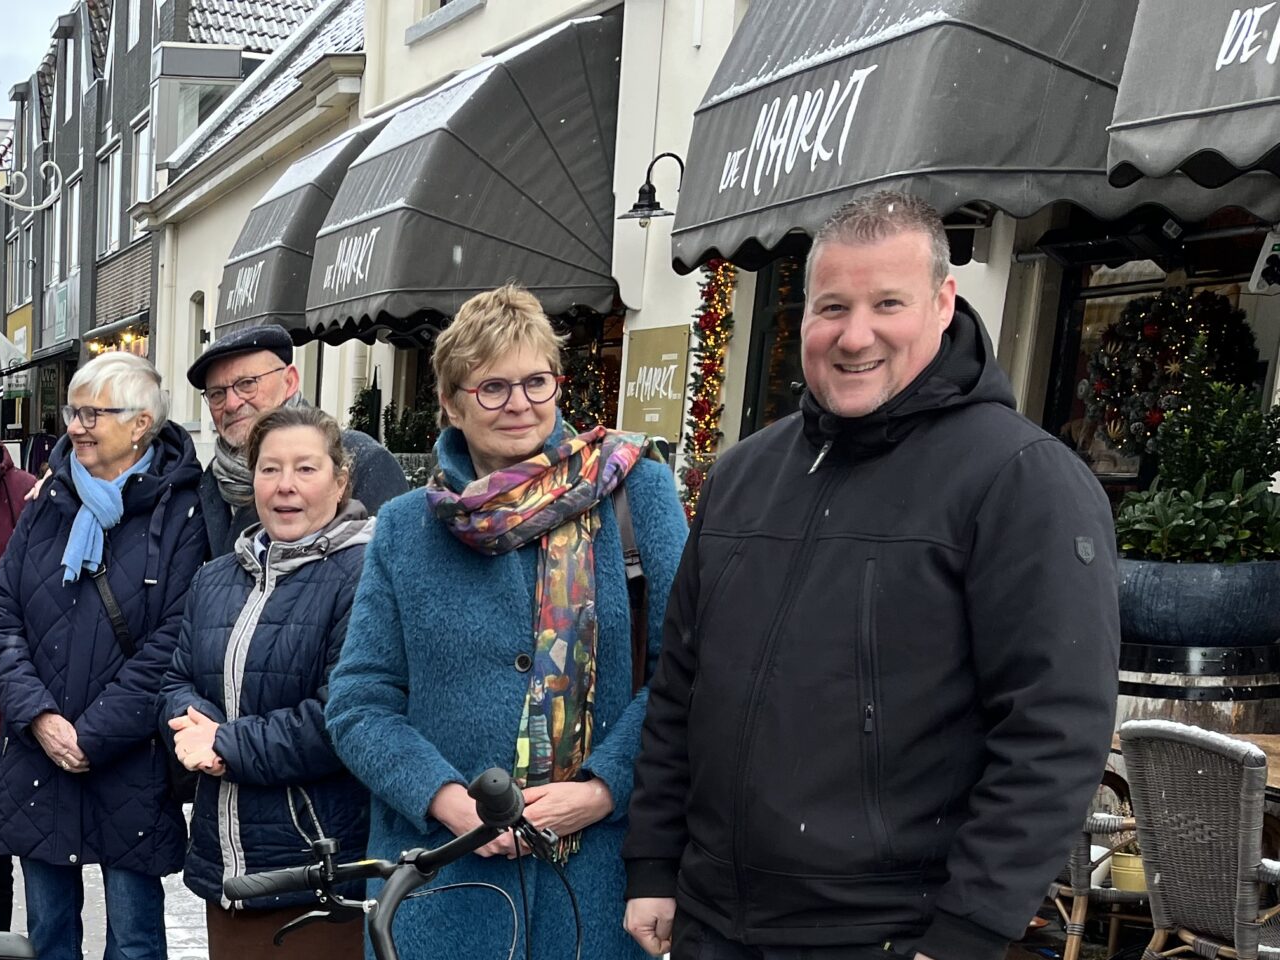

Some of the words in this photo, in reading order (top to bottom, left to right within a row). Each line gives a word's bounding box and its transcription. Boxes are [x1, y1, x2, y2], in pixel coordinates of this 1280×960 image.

[1215, 1, 1278, 71] DE
[718, 147, 748, 194] DE
[740, 64, 879, 197] MARKT
[231, 260, 266, 316] MARKT
[323, 264, 335, 290] DE
[330, 226, 381, 296] MARKT
[634, 364, 680, 403] MARKT
